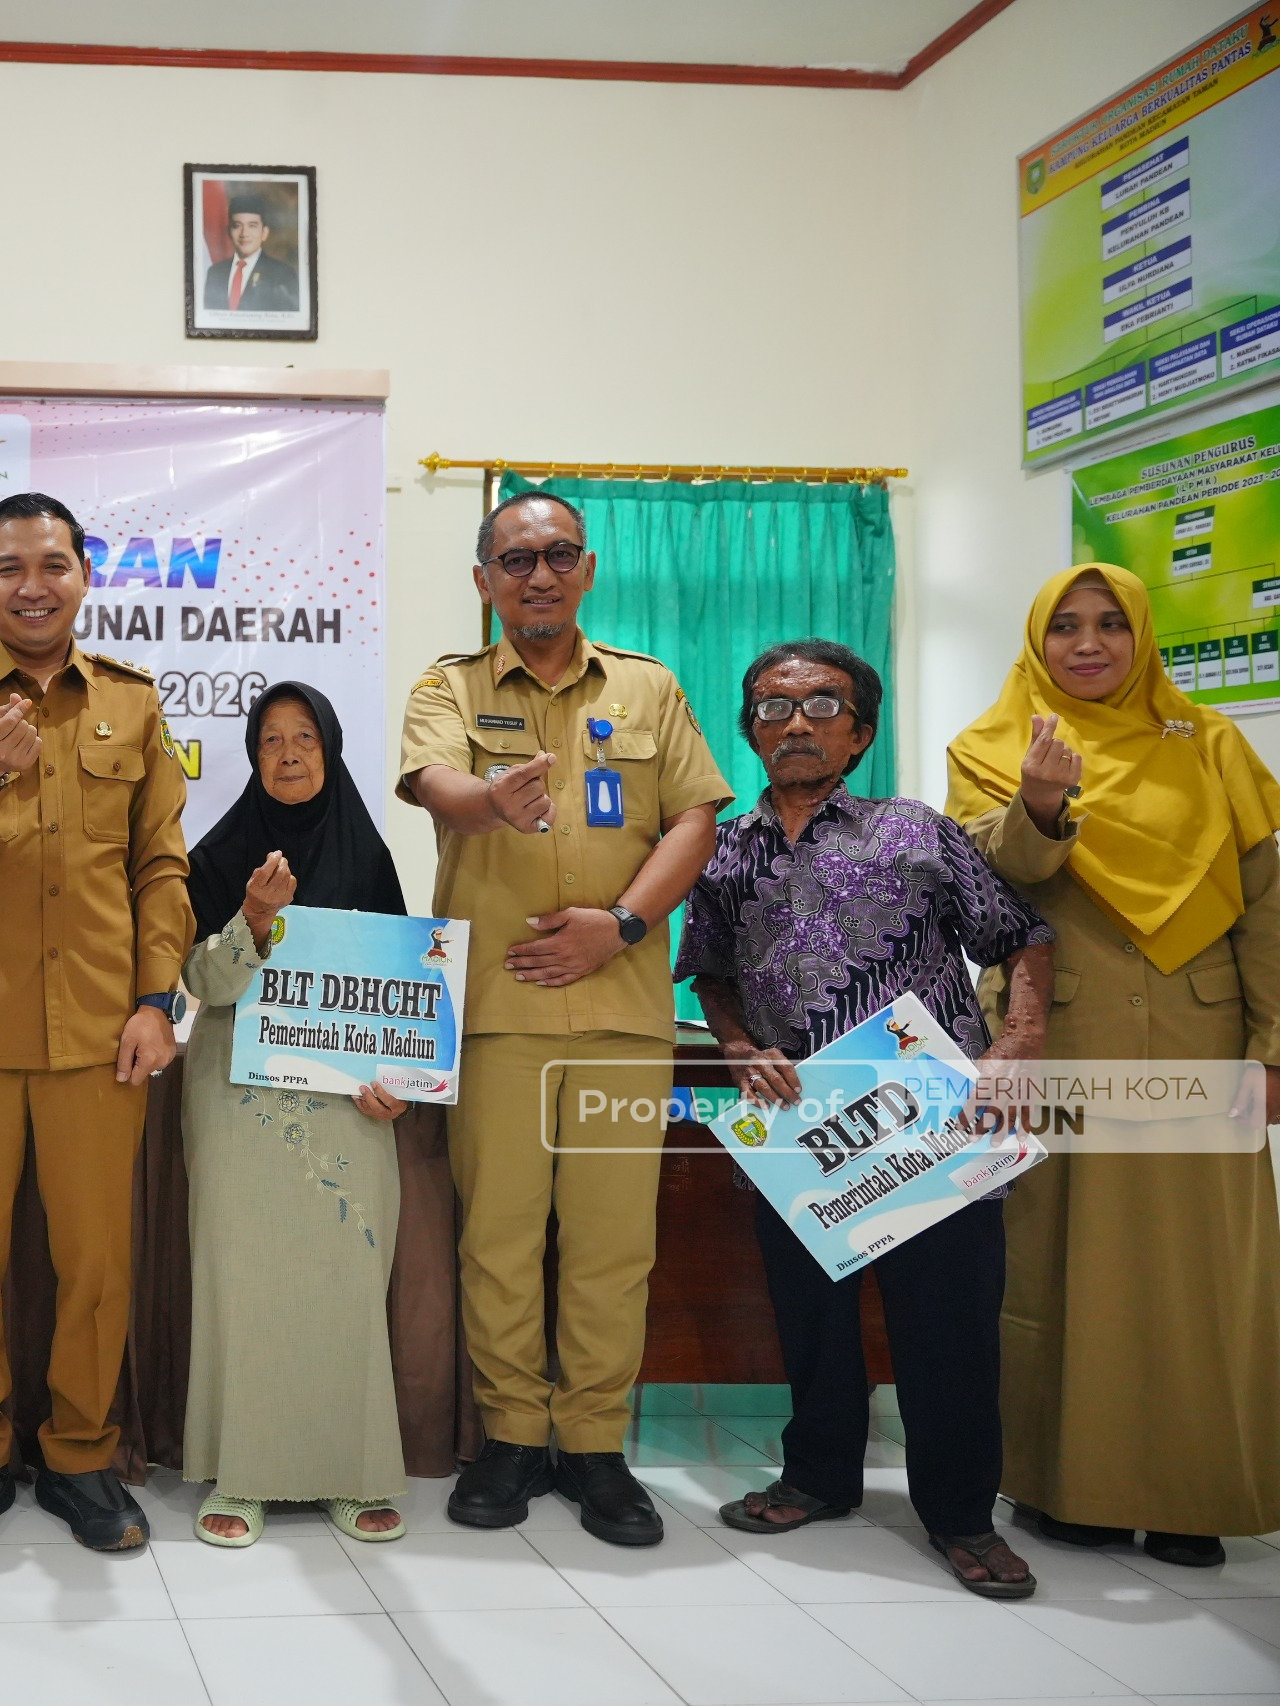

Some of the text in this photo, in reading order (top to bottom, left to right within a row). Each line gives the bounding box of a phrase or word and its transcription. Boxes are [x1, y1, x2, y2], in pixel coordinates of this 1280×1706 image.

[1162, 54, 1201, 88] RUMAH
[1202, 23, 1249, 62] DATAKU
[1092, 113, 1139, 147] KELUARGA
[1141, 69, 1209, 117] BERKUALITAS
[1211, 40, 1252, 76] PANTAS
[1116, 162, 1173, 198] LURAH PANDEAN
[1107, 209, 1184, 254] KELURAHAN PANDEAN
[1120, 212, 1158, 236] PENYULUH
[1133, 255, 1158, 272] KETUA
[1137, 261, 1174, 283] NURDIANA
[1136, 301, 1174, 325] FEBRIANTI
[1141, 457, 1191, 479] SUSUNAN
[1193, 436, 1255, 465] PENGURUS
[1090, 489, 1127, 506] LEMBAGA
[1129, 470, 1195, 495] PEMBERDAYAAN
[1197, 451, 1258, 476] MASYARAKAT
[1106, 503, 1157, 523] KELURAHAN
[1158, 492, 1199, 509] PANDEAN
[1201, 482, 1240, 499] PERIODE
[1242, 474, 1265, 488] 2023
[181, 606, 342, 645] DAERAH
[158, 671, 268, 718] 2026
[421, 954, 453, 964] MADIUN
[259, 967, 442, 1020] BLT DBHCHT
[258, 1016, 435, 1060] Pemerintah Kota Madiun
[897, 1034, 929, 1059] MADIUN
[248, 1072, 309, 1085] Dinsos PPPA
[382, 1075, 434, 1090] bankjatim
[796, 1081, 921, 1177] BLTD
[808, 1165, 900, 1230] Pemerintah
[884, 1144, 935, 1182] Kota
[962, 1152, 1015, 1188] bankjatim
[836, 1233, 896, 1272] Dinsos PPPA
